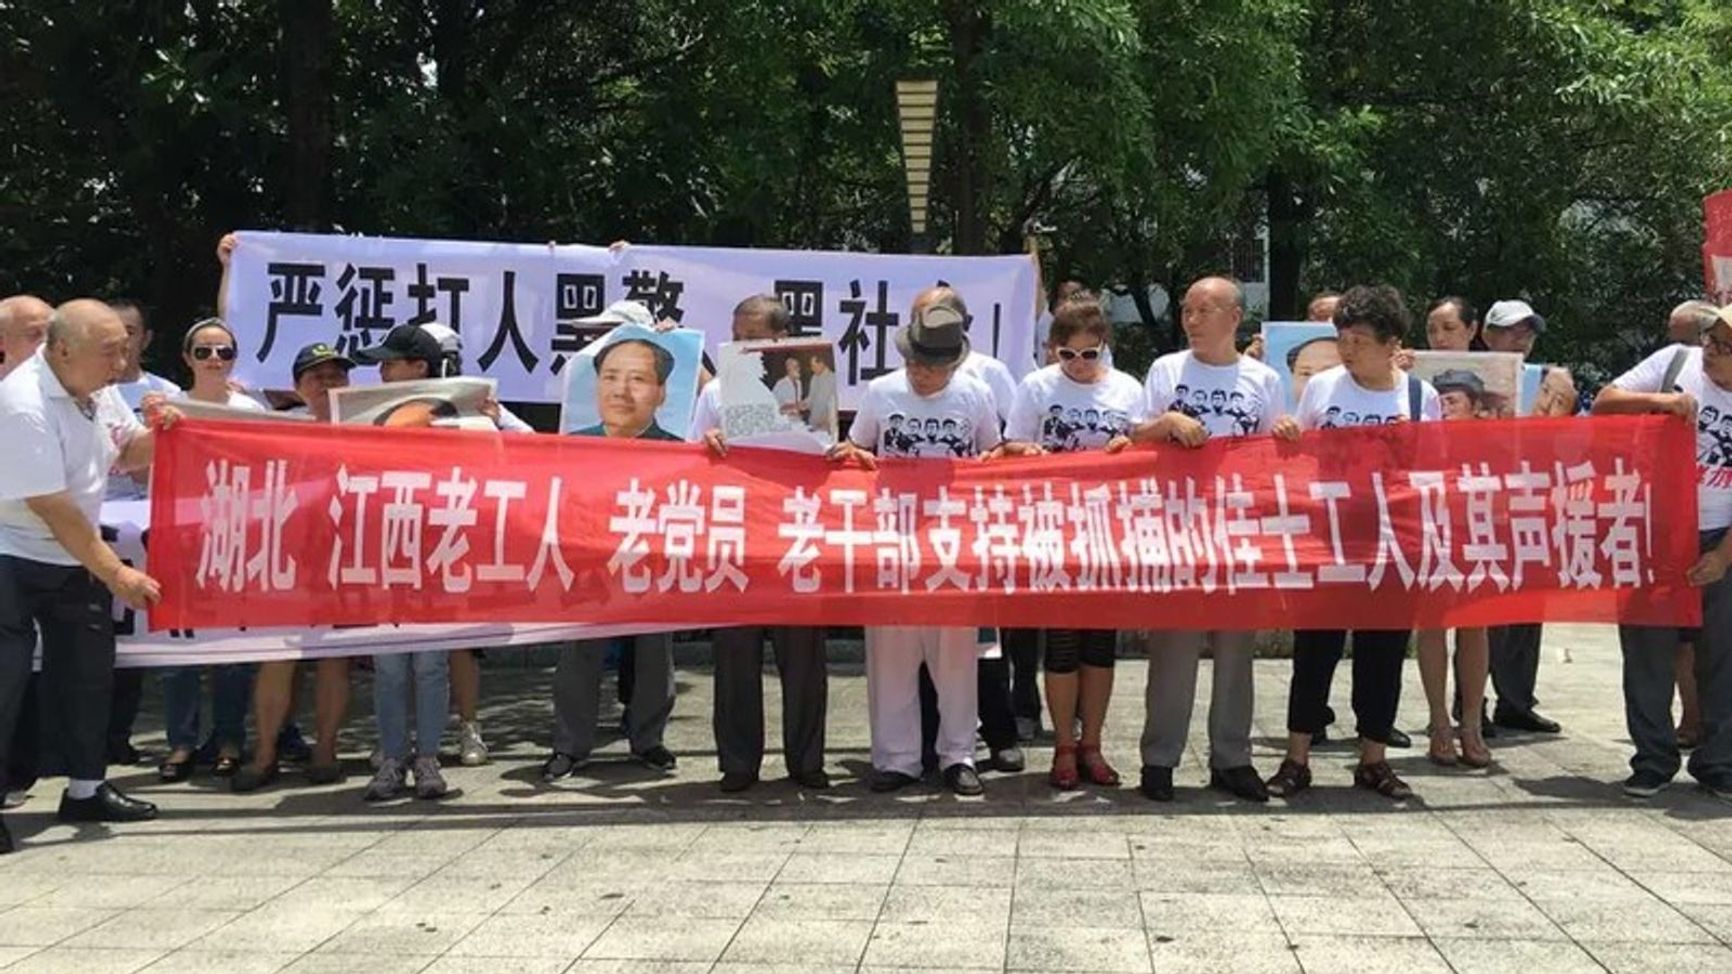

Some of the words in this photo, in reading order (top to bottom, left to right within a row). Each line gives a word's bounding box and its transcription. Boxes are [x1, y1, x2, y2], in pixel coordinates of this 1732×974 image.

[196, 460, 297, 592] 湖北
[328, 466, 576, 593] 江西老工人
[608, 477, 748, 593] 老党员
